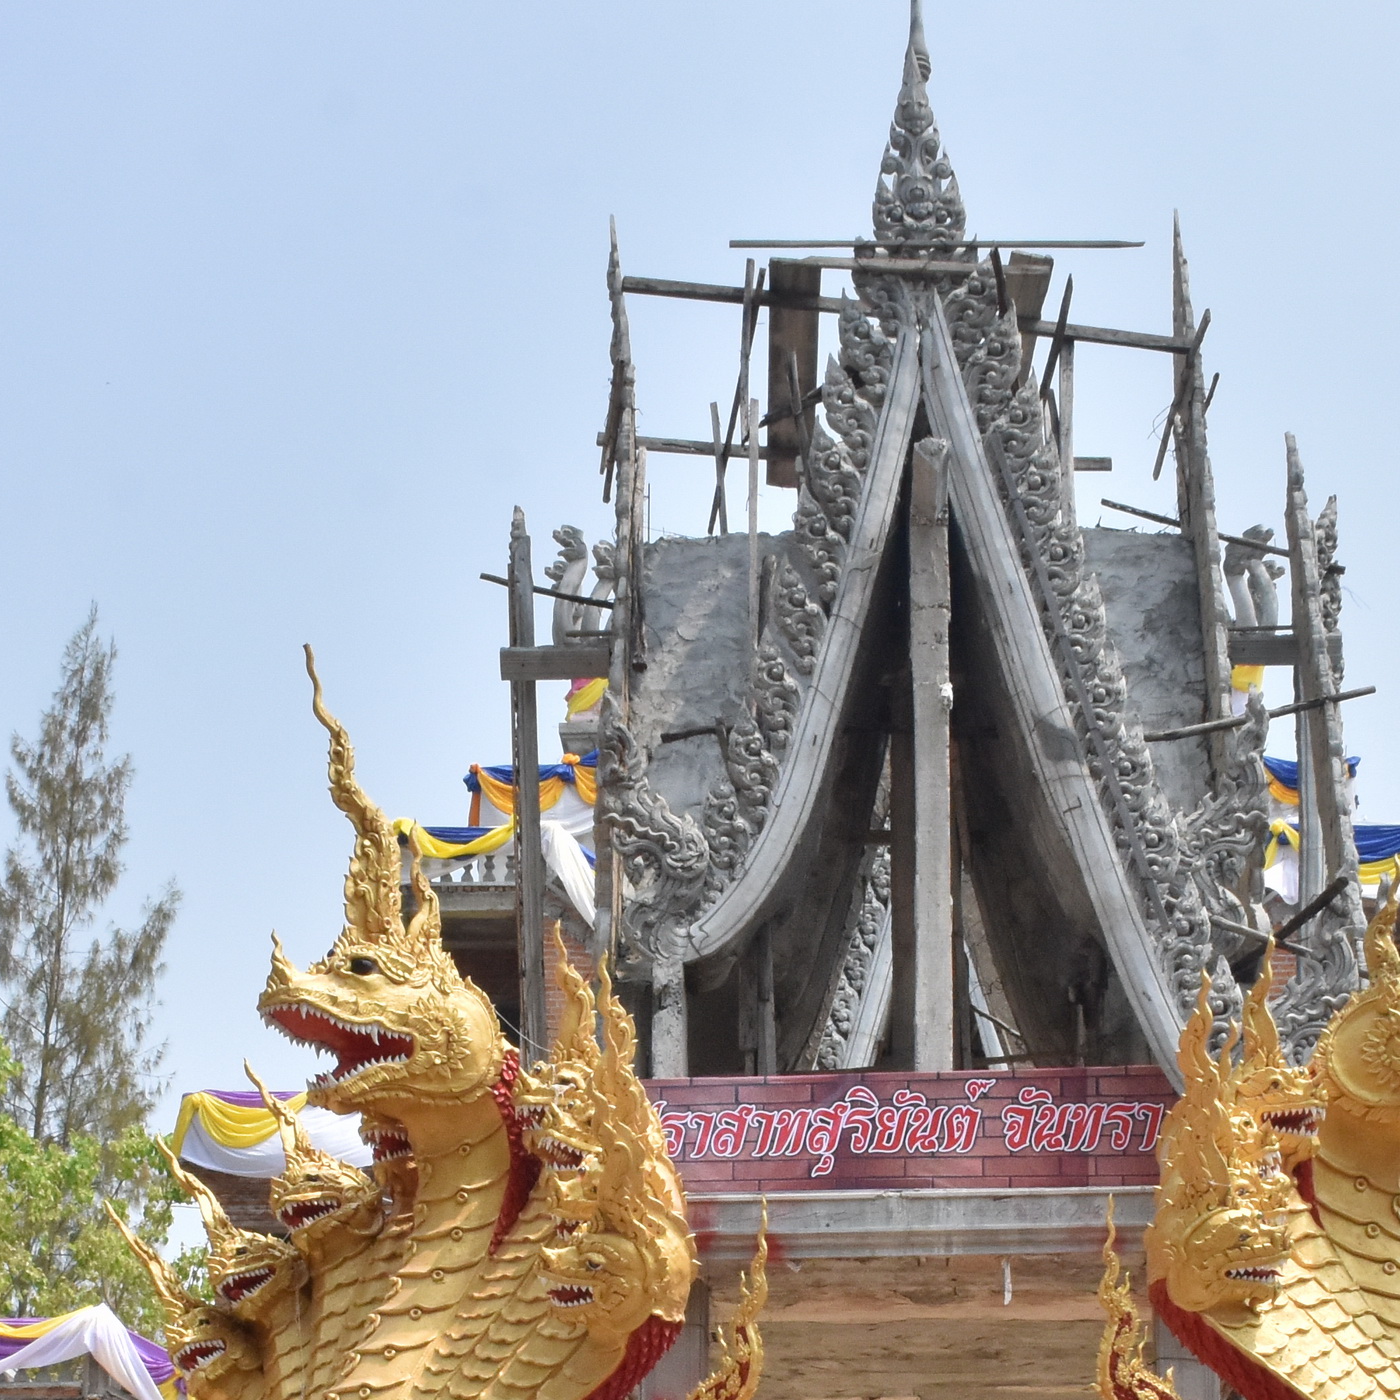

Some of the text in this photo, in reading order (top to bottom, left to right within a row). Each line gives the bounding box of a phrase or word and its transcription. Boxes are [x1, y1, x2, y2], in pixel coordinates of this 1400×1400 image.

[653, 1079, 1165, 1176] ราสาทสุริยันต์ จันทรา
